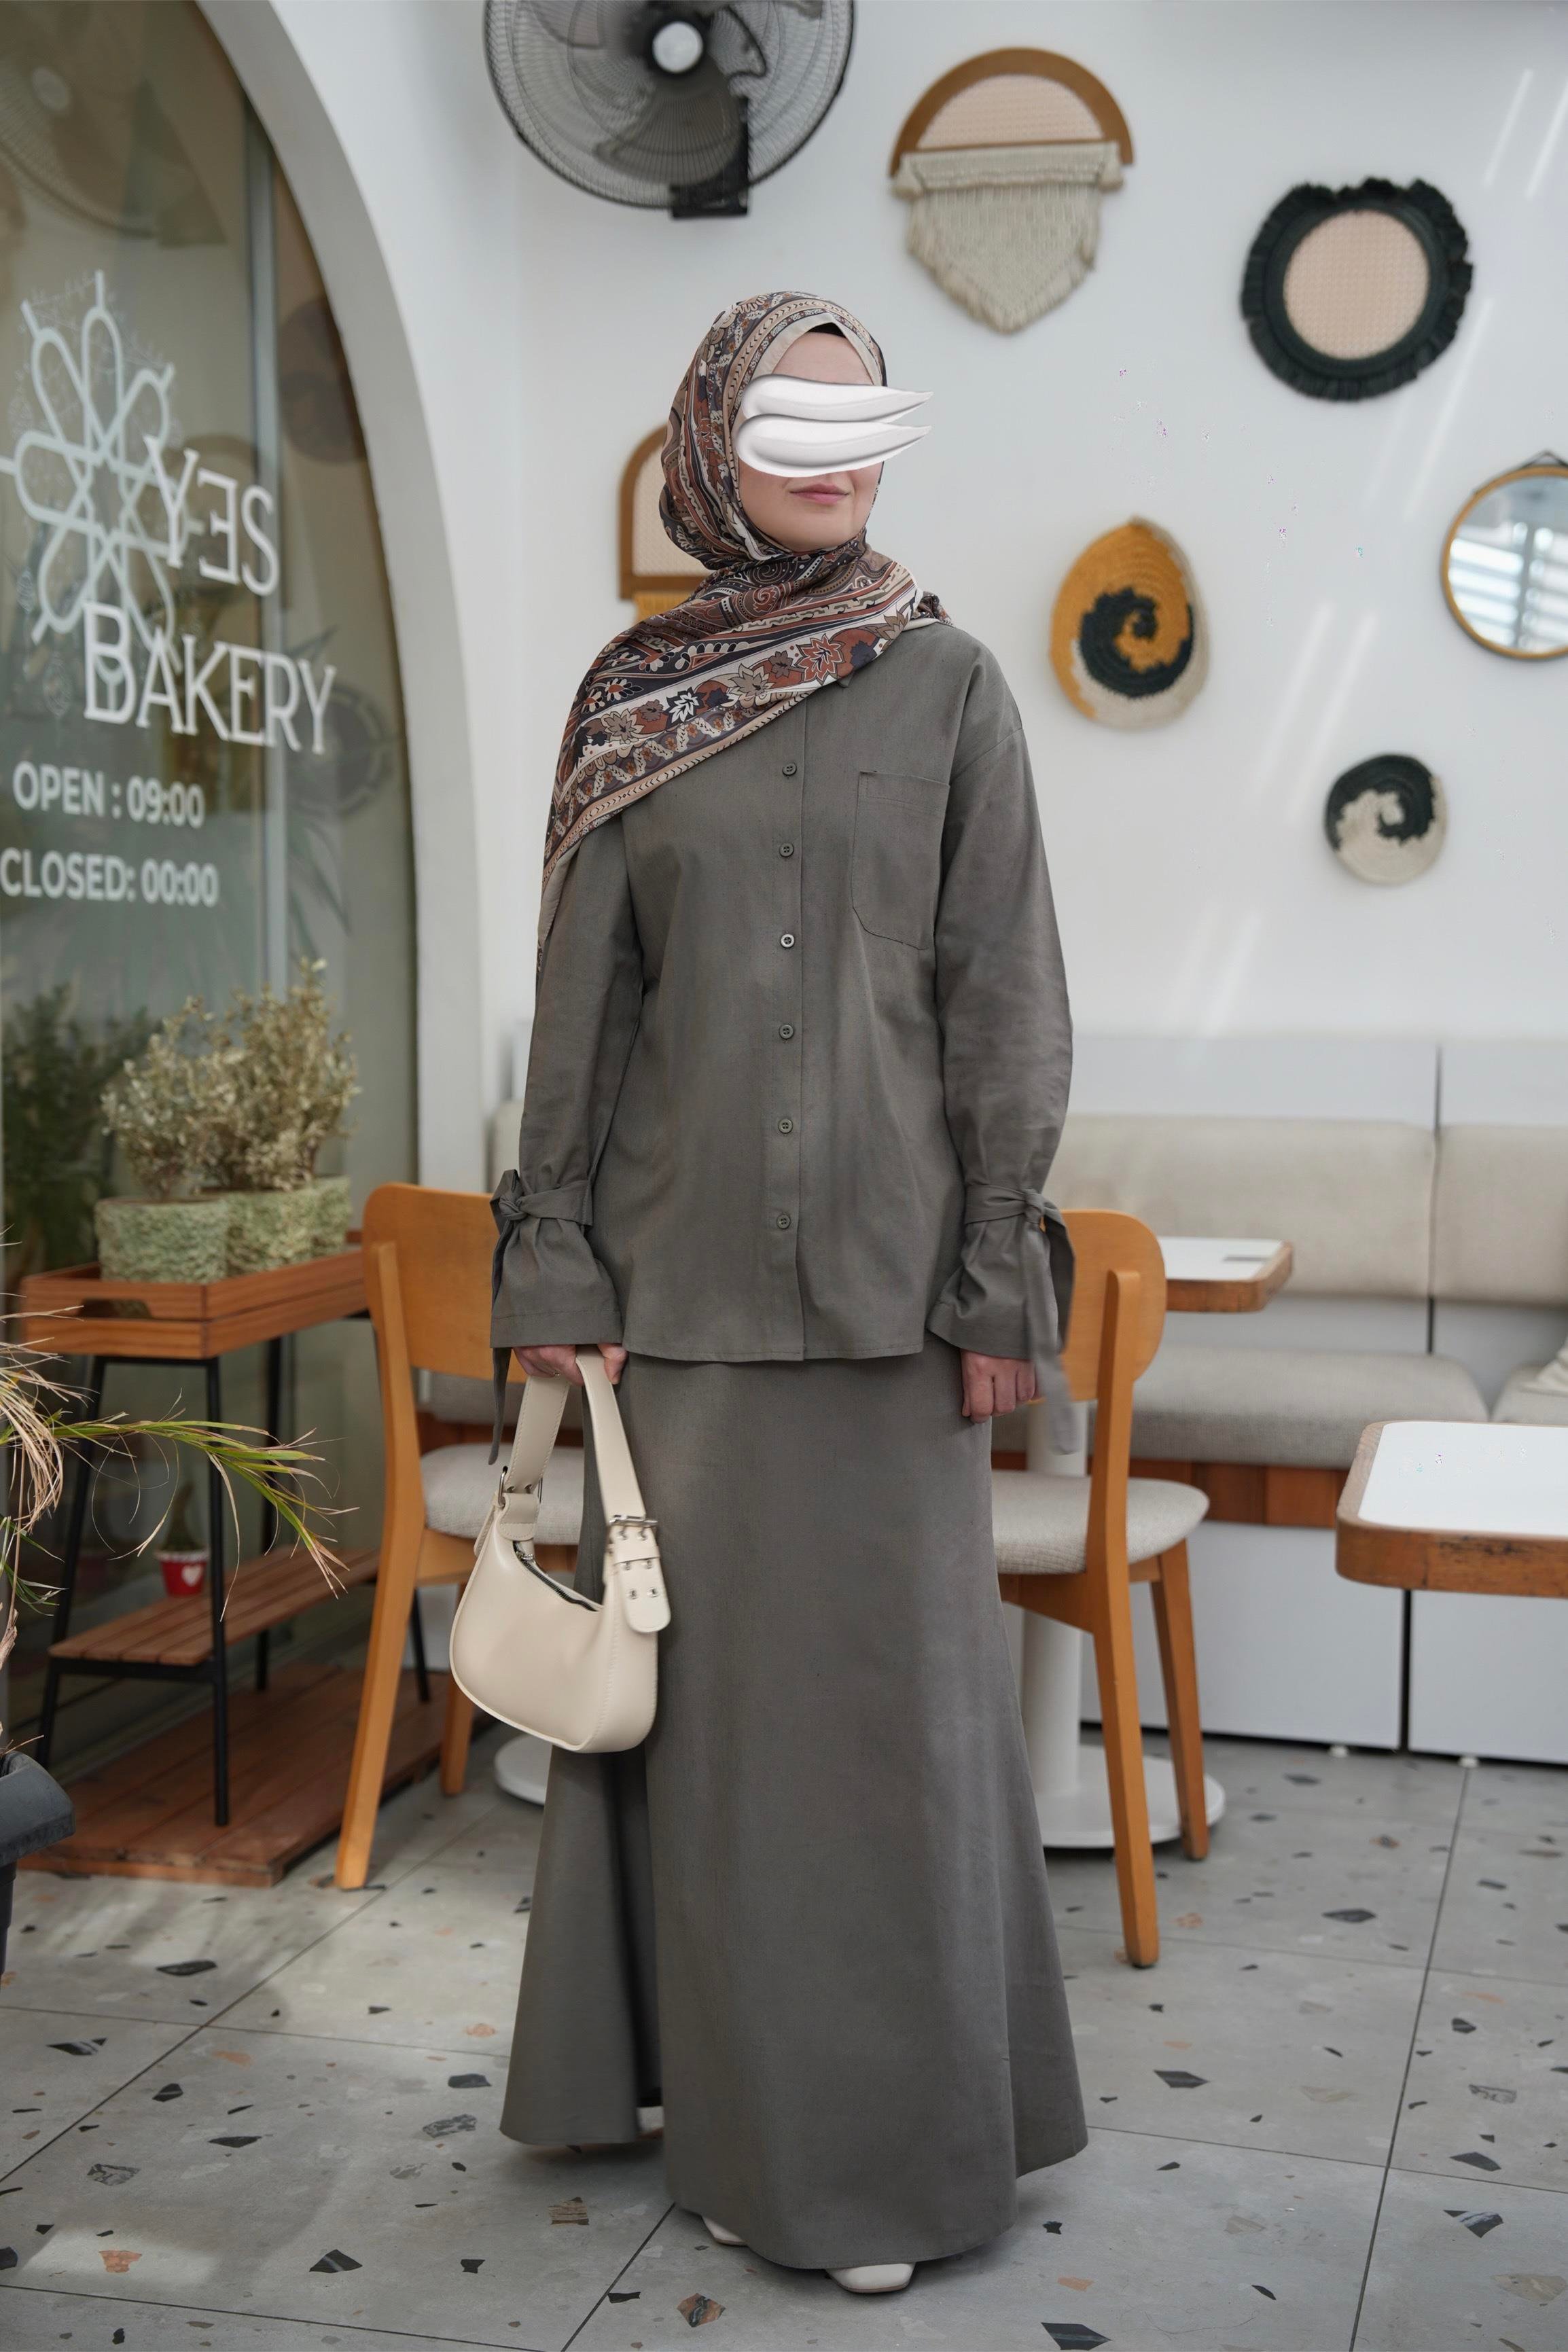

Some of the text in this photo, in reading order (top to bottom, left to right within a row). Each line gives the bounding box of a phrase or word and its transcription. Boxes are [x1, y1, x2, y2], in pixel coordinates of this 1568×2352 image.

[81, 601, 338, 755] BAKERY
[12, 760, 105, 817] OPEN
[126, 775, 204, 829] 09:00
[141, 858, 218, 907] 00:00
